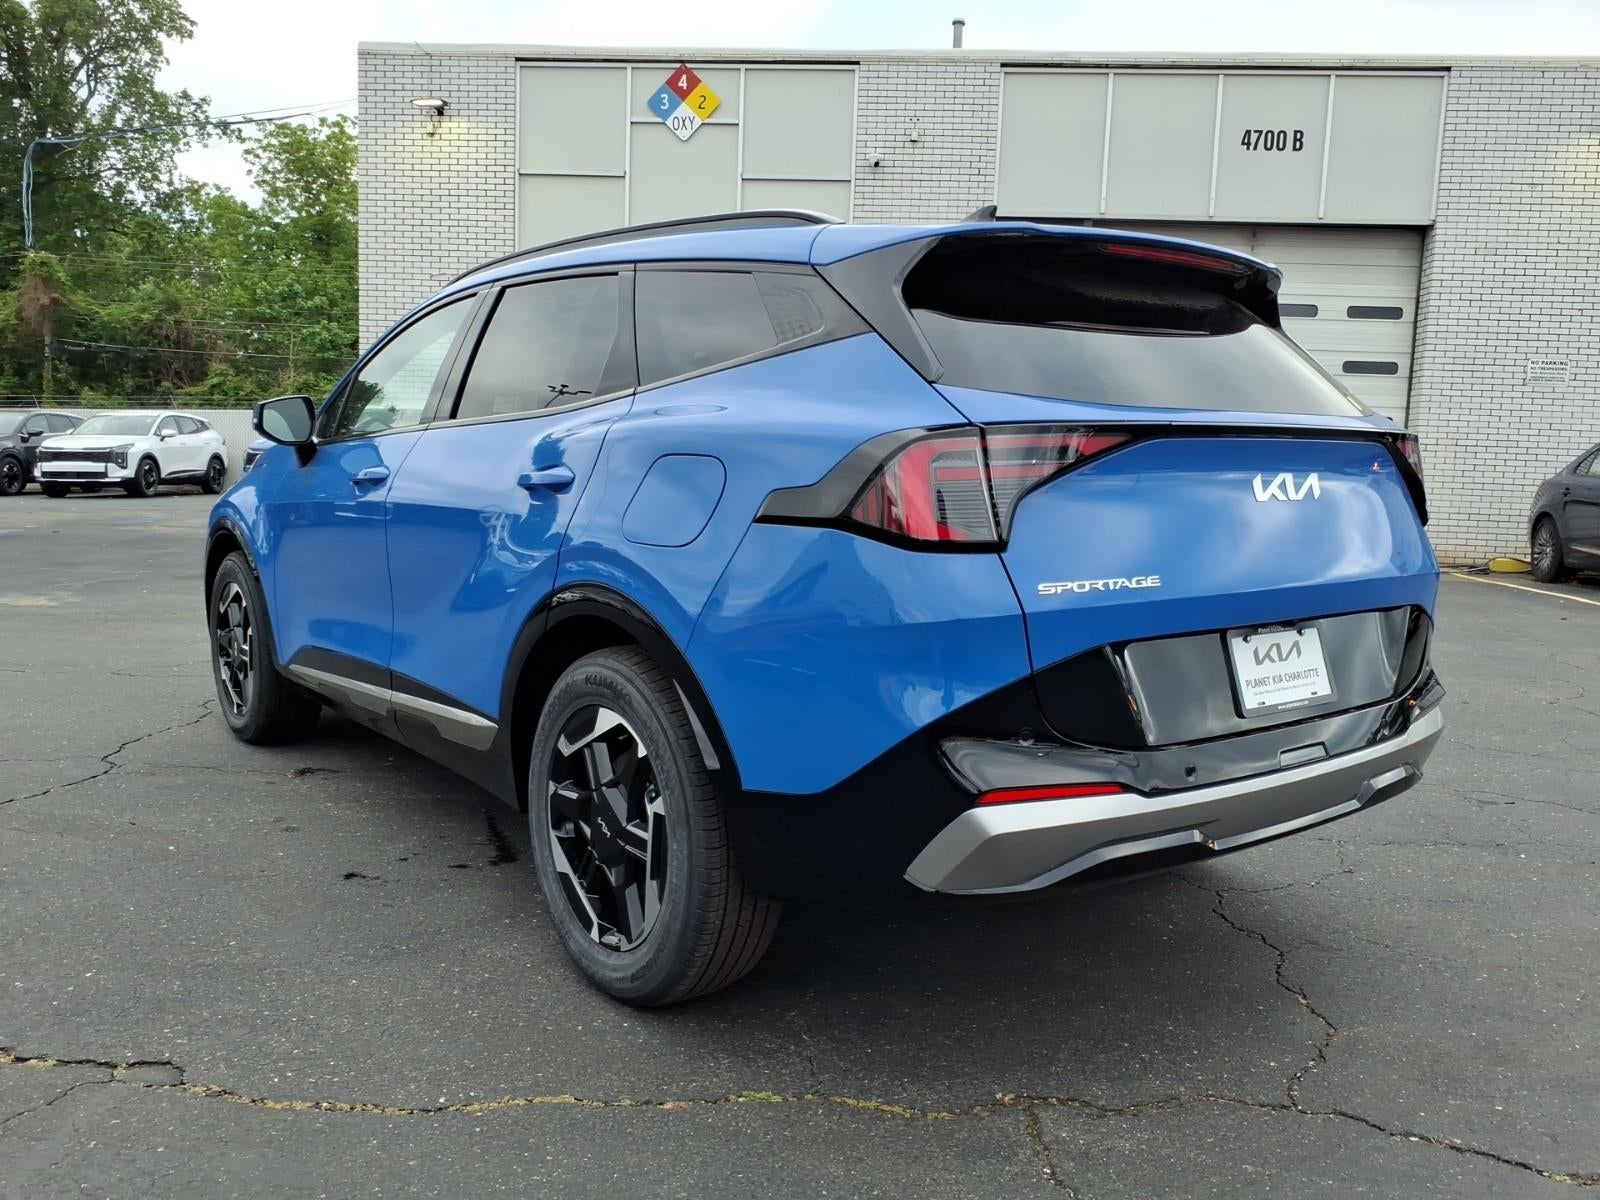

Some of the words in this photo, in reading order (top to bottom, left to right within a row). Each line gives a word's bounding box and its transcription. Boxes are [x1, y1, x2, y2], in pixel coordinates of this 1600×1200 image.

[678, 74, 688, 90] 4
[660, 93, 669, 110] 3
[698, 94, 707, 110] 2
[672, 116, 696, 131] OXY
[1240, 129, 1288, 152] 4700
[1291, 129, 1305, 152] B
[1252, 472, 1321, 502] KIA
[1037, 575, 1162, 595] SPORTAGE
[1253, 640, 1302, 666] KIA
[1245, 676, 1271, 689] PLANET
[1272, 673, 1285, 684] KIA
[1284, 668, 1320, 683] CHARLOTTE
